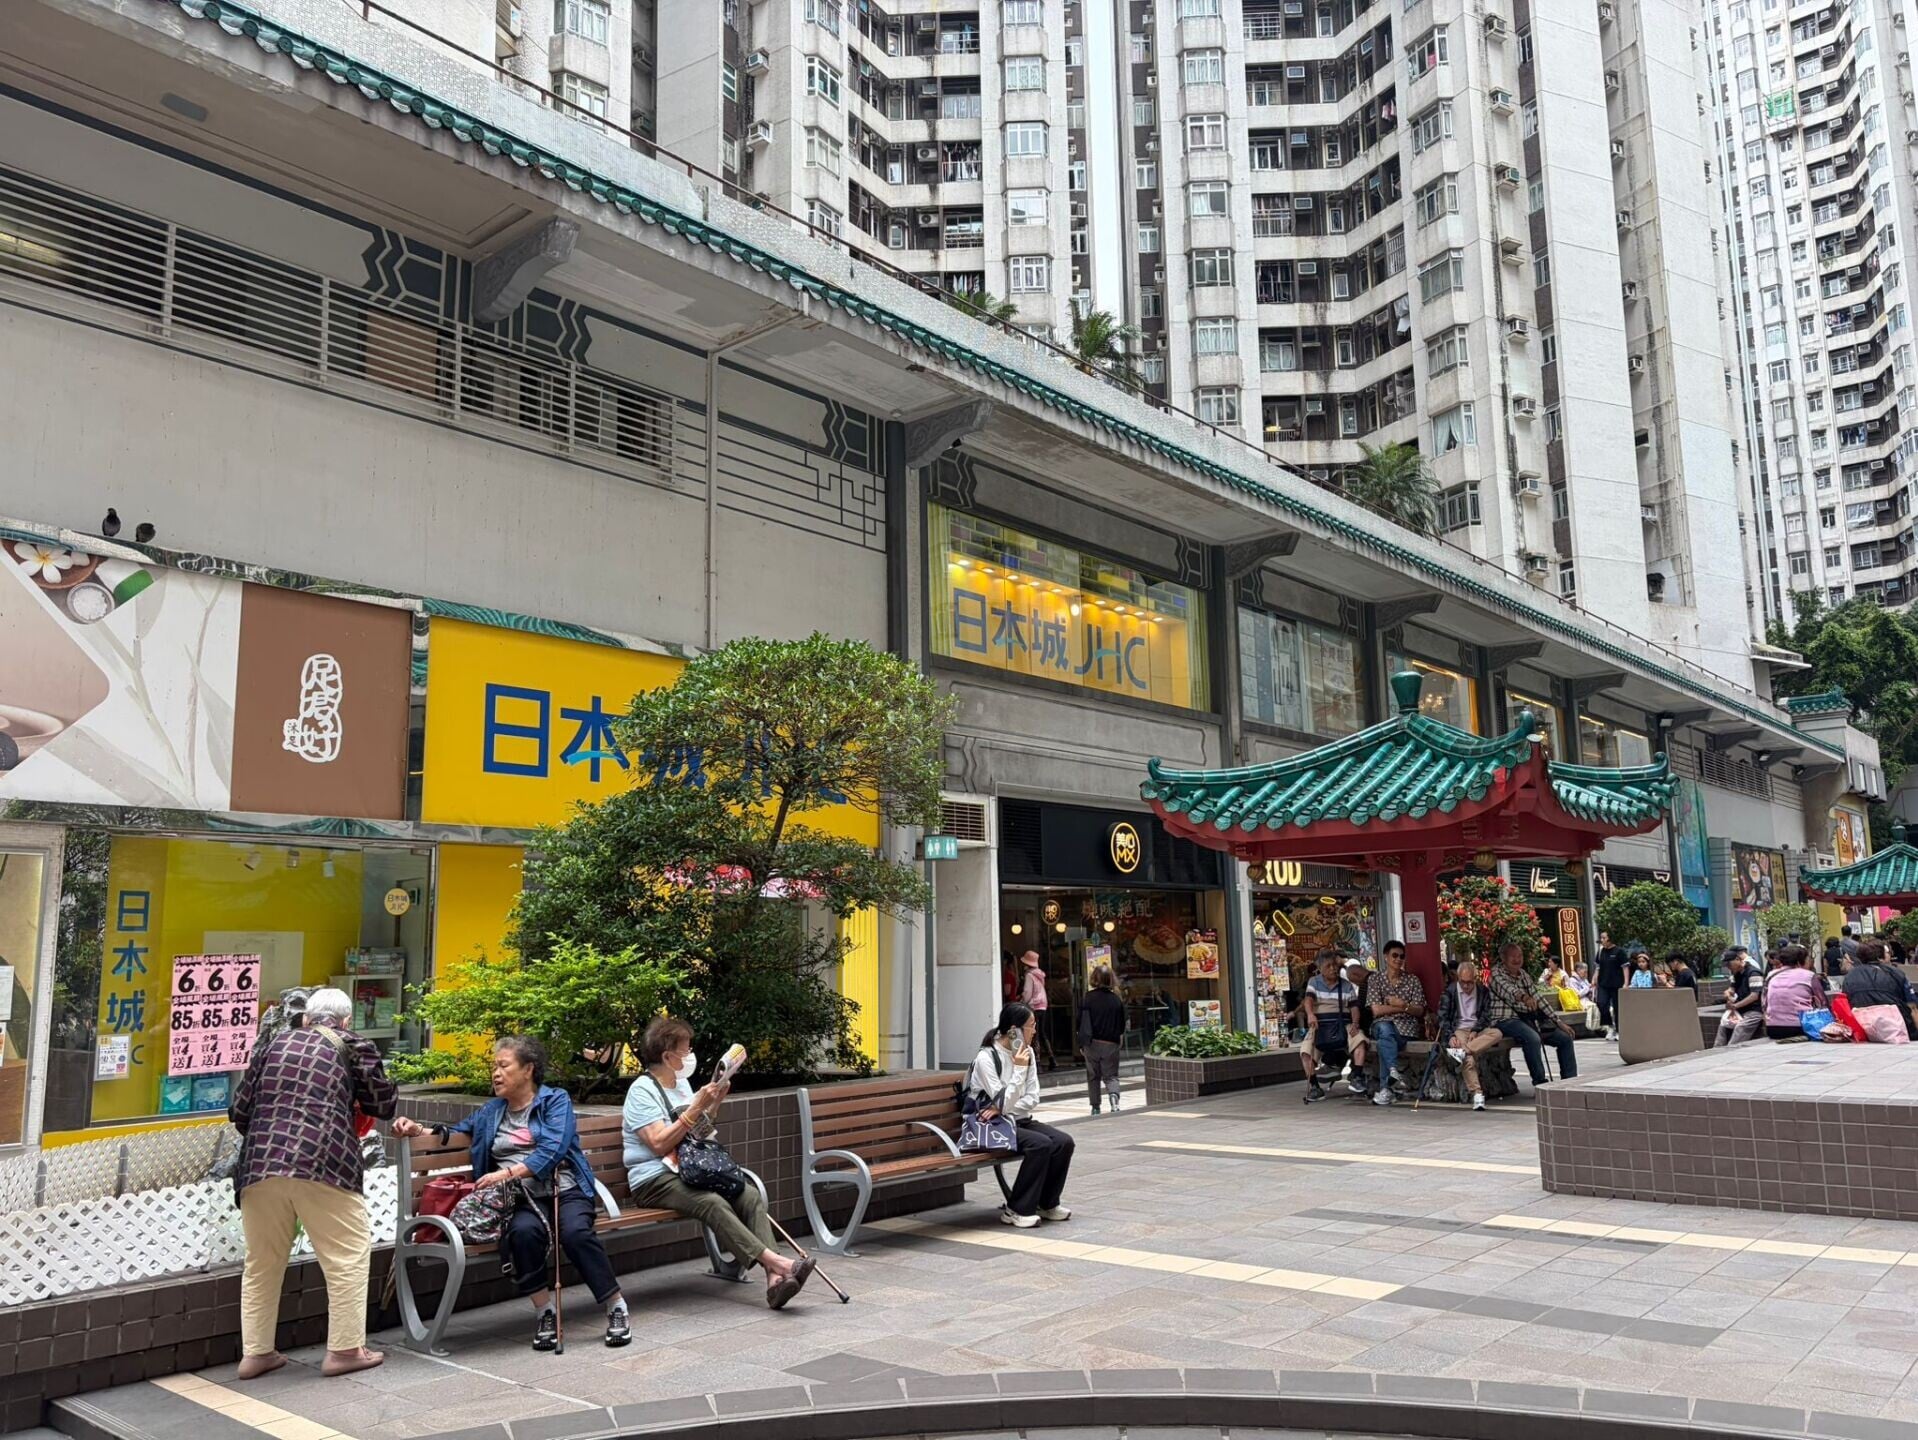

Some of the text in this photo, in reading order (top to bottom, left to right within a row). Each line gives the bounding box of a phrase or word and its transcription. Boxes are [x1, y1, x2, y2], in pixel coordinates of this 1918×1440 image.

[953, 587, 1147, 690] 日本城 JHC
[1116, 848, 1136, 863] MX
[107, 890, 150, 1033] 日本城
